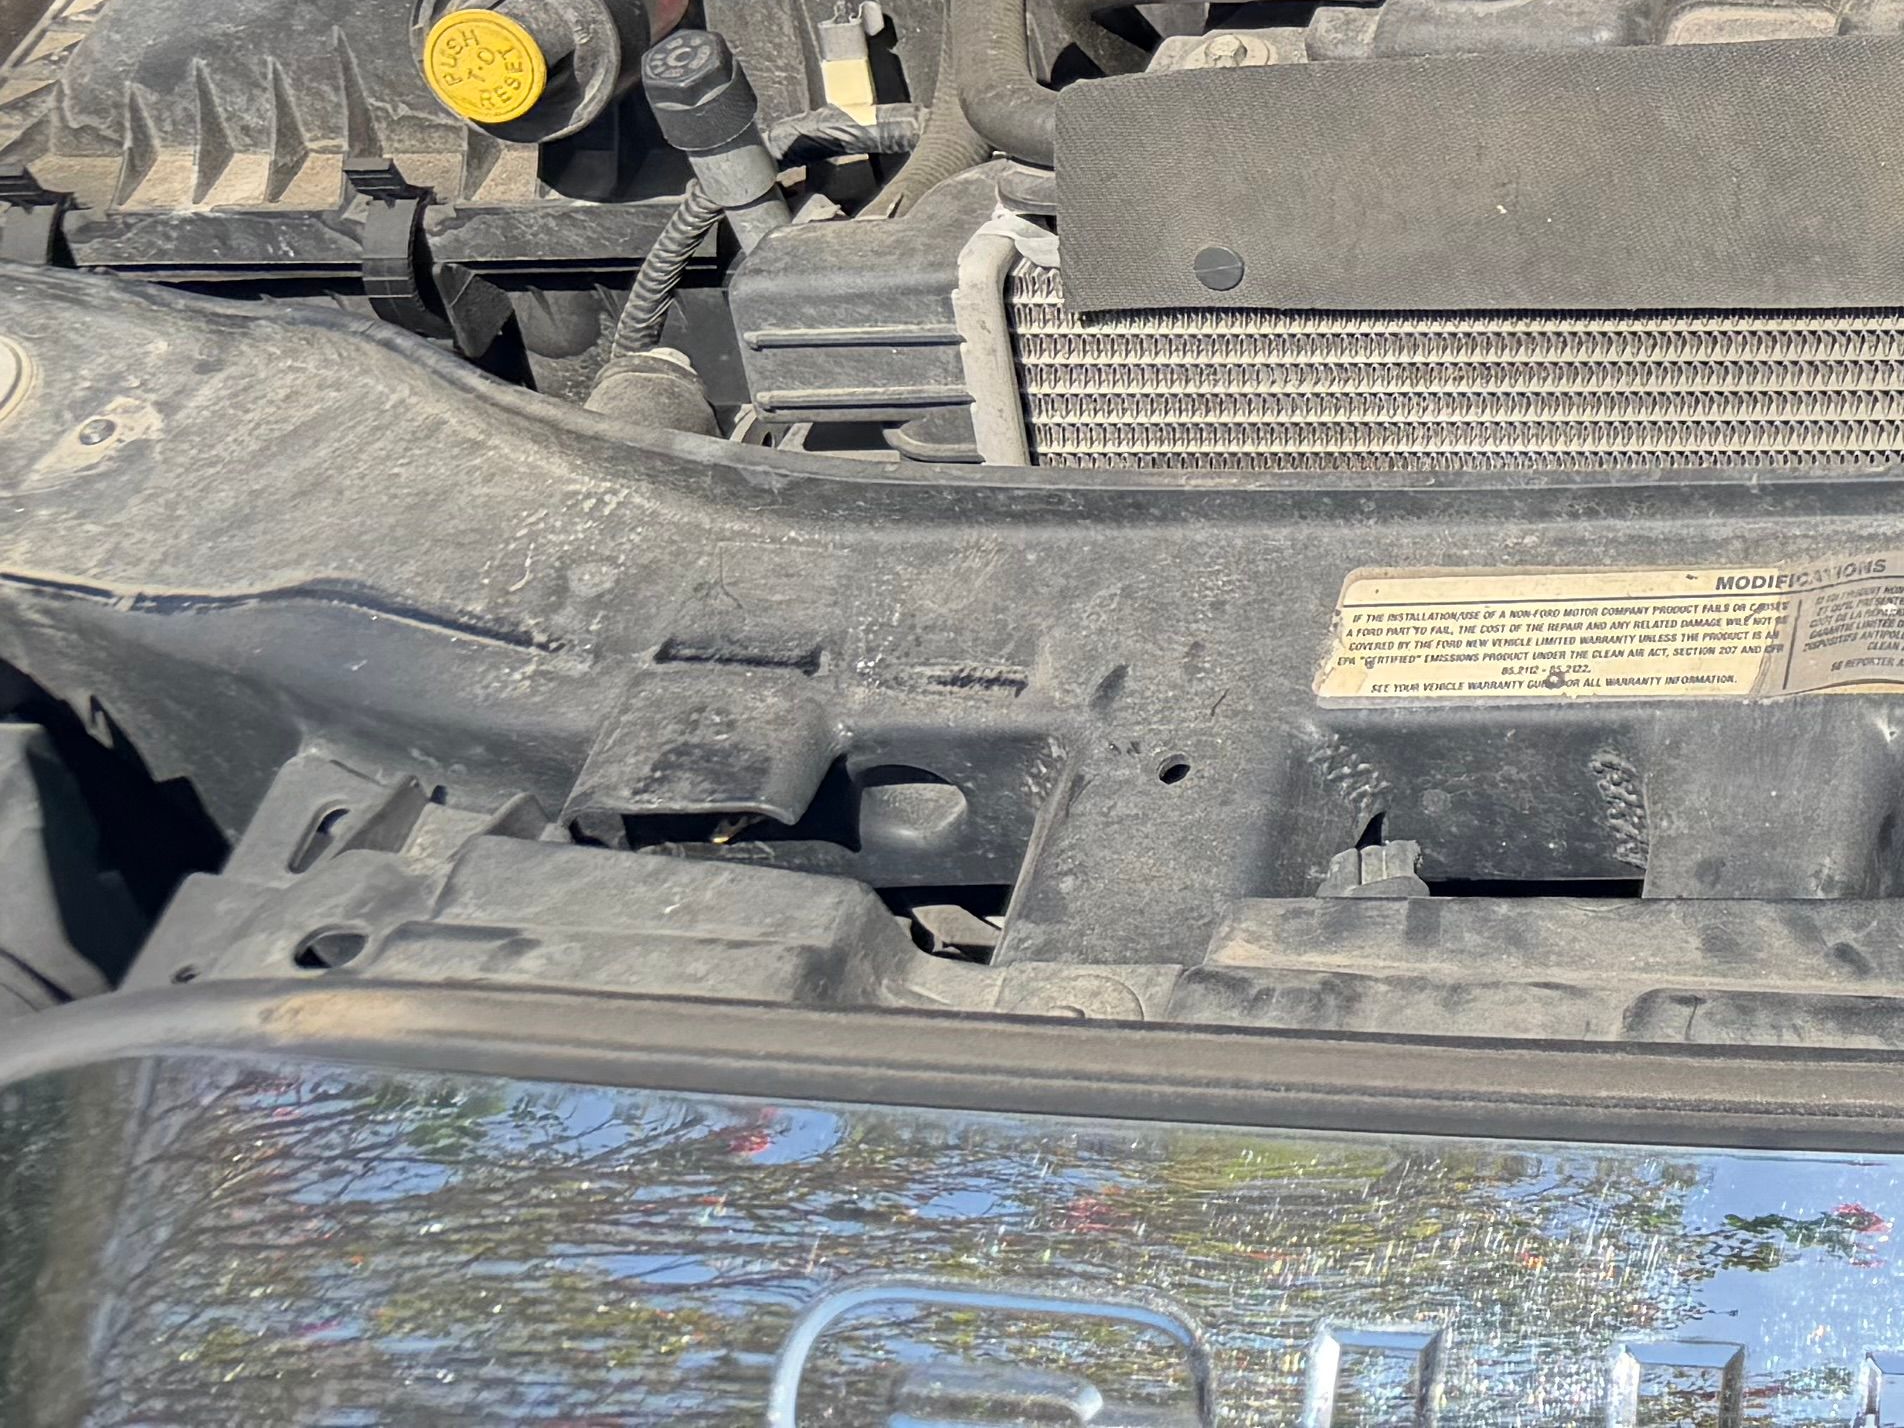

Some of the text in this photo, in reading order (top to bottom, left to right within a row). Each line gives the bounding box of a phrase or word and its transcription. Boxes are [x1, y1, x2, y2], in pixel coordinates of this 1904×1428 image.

[442, 29, 480, 86] PUSH
[480, 46, 523, 108] RESET
[1366, 614, 1382, 623] THE
[1484, 610, 1496, 619] OF
[1563, 607, 1598, 617] MOTOR
[1601, 605, 1649, 616] COMPANY
[1652, 604, 1699, 615] PRODUCT
[1356, 628, 1383, 637] FORD
[1458, 625, 1476, 634] THE
[1480, 624, 1506, 633] COST
[1509, 624, 1522, 633] OF
[1526, 623, 1544, 632] THE
[1547, 622, 1583, 632] REPAIR
[1586, 621, 1607, 631] AND
[1609, 620, 1630, 630] ANY
[1633, 619, 1677, 629] RELATED
[1680, 617, 1722, 628] DAMAGE
[1349, 642, 1394, 652] COVERED
[1398, 641, 1412, 650] BY
[1414, 640, 1432, 650] THE
[1436, 640, 1462, 649] FORD
[1466, 639, 1489, 648] NEW
[1492, 637, 1532, 647] VEHICLE
[1535, 636, 1575, 646] LIMITED
[1579, 635, 1636, 645] WARRANTY
[1639, 633, 1677, 643] UNLESS
[1681, 632, 1699, 642] THE
[1702, 631, 1749, 642] PRODUCT
[1752, 631, 1762, 640] IS
[1337, 656, 1356, 666] EPA
[1424, 653, 1479, 663] EMISSIONS
[1482, 652, 1529, 662] PRODUCT
[1532, 651, 1567, 661] UNDER
[1570, 650, 1588, 659] THE
[1591, 649, 1624, 659] CLEAN
[1672, 646, 1716, 656] SECTION
[1719, 645, 1737, 655] 207
[1740, 644, 1762, 654] AND
[1371, 684, 1390, 693] SEE
[1394, 683, 1419, 693] YOUR
[1423, 682, 1464, 692] VEHICLE
[1467, 680, 1524, 691] WARRANTY
[1583, 678, 1601, 687] ALL
[1605, 677, 1661, 687] WARRANTY
[1664, 675, 1738, 686] INFORMATION.
